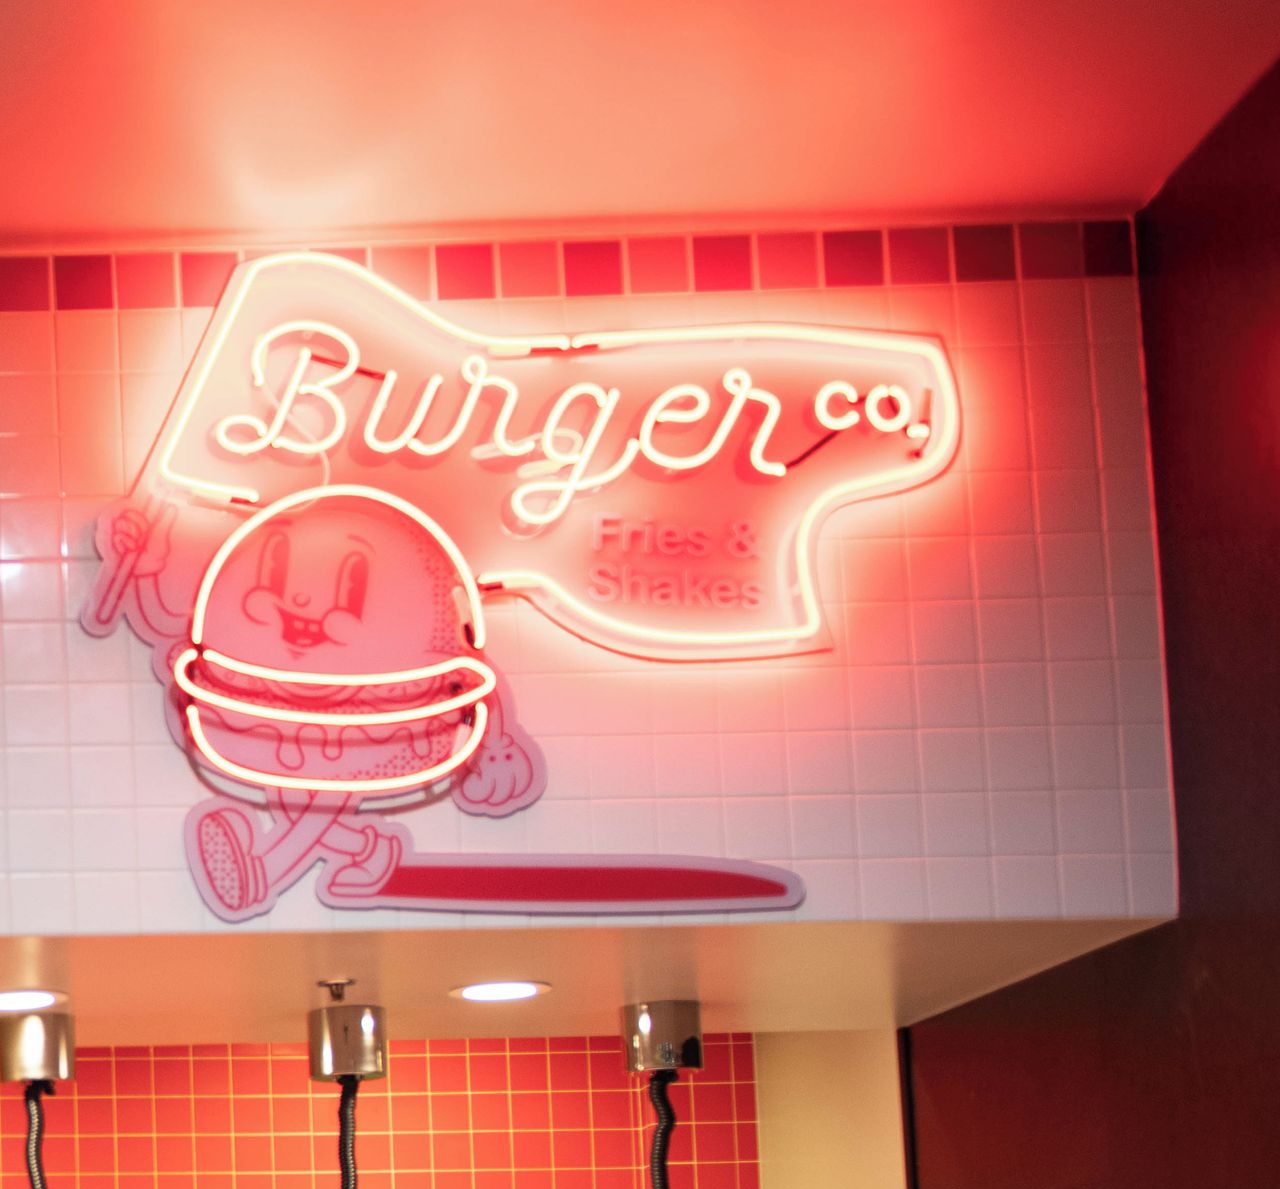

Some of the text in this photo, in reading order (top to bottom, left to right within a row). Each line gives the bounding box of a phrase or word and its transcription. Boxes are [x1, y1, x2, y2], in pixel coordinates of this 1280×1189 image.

[215, 319, 787, 524] Burger
[591, 513, 761, 559] Fries &
[588, 561, 767, 610] Shakes
